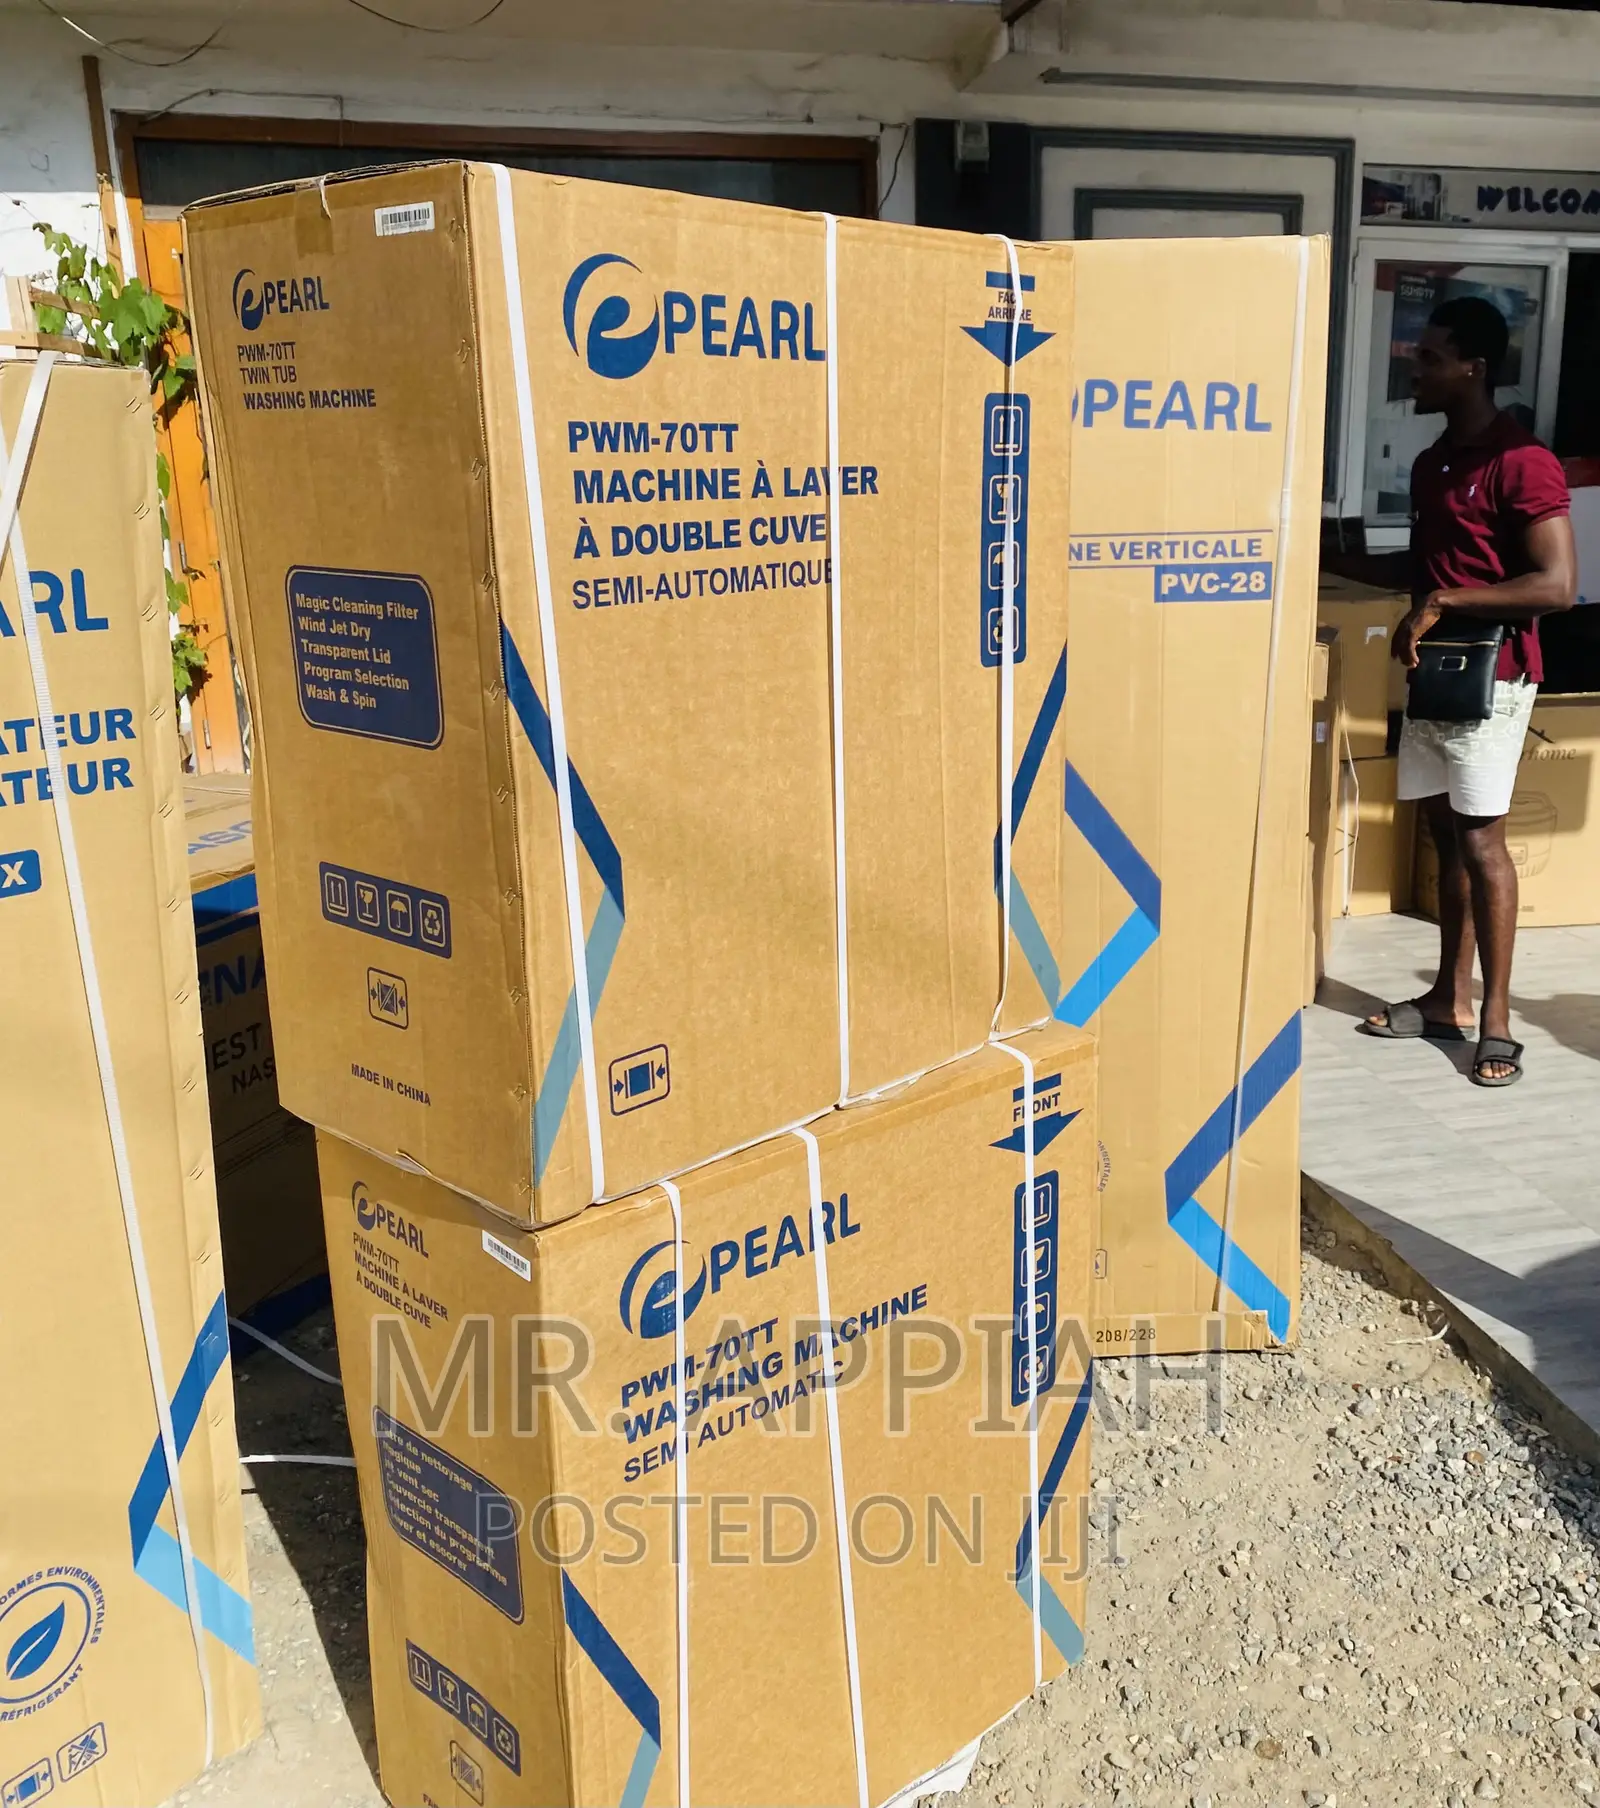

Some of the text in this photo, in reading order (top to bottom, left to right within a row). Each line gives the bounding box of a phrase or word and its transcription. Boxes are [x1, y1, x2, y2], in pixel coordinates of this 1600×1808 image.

[997, 291, 1023, 304] FAC
[987, 306, 1032, 321] ARRIRE
[236, 341, 296, 362] PWM-70TT
[240, 365, 297, 385] TWIN TUB
[243, 388, 377, 411] WASHING MACHINE
[567, 420, 740, 454] PWM-70TT
[572, 467, 742, 504] MACHINE
[751, 460, 774, 499] À
[573, 513, 827, 559] À DOUBLE CUVE
[1109, 538, 1263, 562] VERTICALE
[1160, 570, 1267, 596] PVC-28
[295, 593, 419, 620] Magic Cleaning Filter
[298, 616, 371, 642] Wind Jet Dry
[301, 638, 392, 665] Transparent Lid
[303, 661, 410, 691] Program Selection
[305, 683, 377, 710] Wash & Spin
[351, 1063, 432, 1107] MADE IN CHINA
[1013, 1091, 1061, 1122] FONT
[353, 1231, 400, 1274] PWM-70TT
[354, 1250, 400, 1291] MACHINE
[412, 1287, 449, 1322] LAVER
[363, 1276, 402, 1311] DOUBLE
[403, 1302, 432, 1329] CUVE
[1096, 1327, 1156, 1343] 208/228
[620, 1317, 779, 1410] PWM-70TT
[622, 1283, 928, 1445] WASHING MACHINE
[404, 1440, 419, 1456] de
[421, 1452, 474, 1494] nettoyage
[396, 1467, 420, 1490] vent
[420, 1484, 440, 1503] sec
[416, 1530, 428, 1544] et
[433, 1521, 447, 1541] du
[47, 1566, 105, 1644] ENVIRONMENTALES
